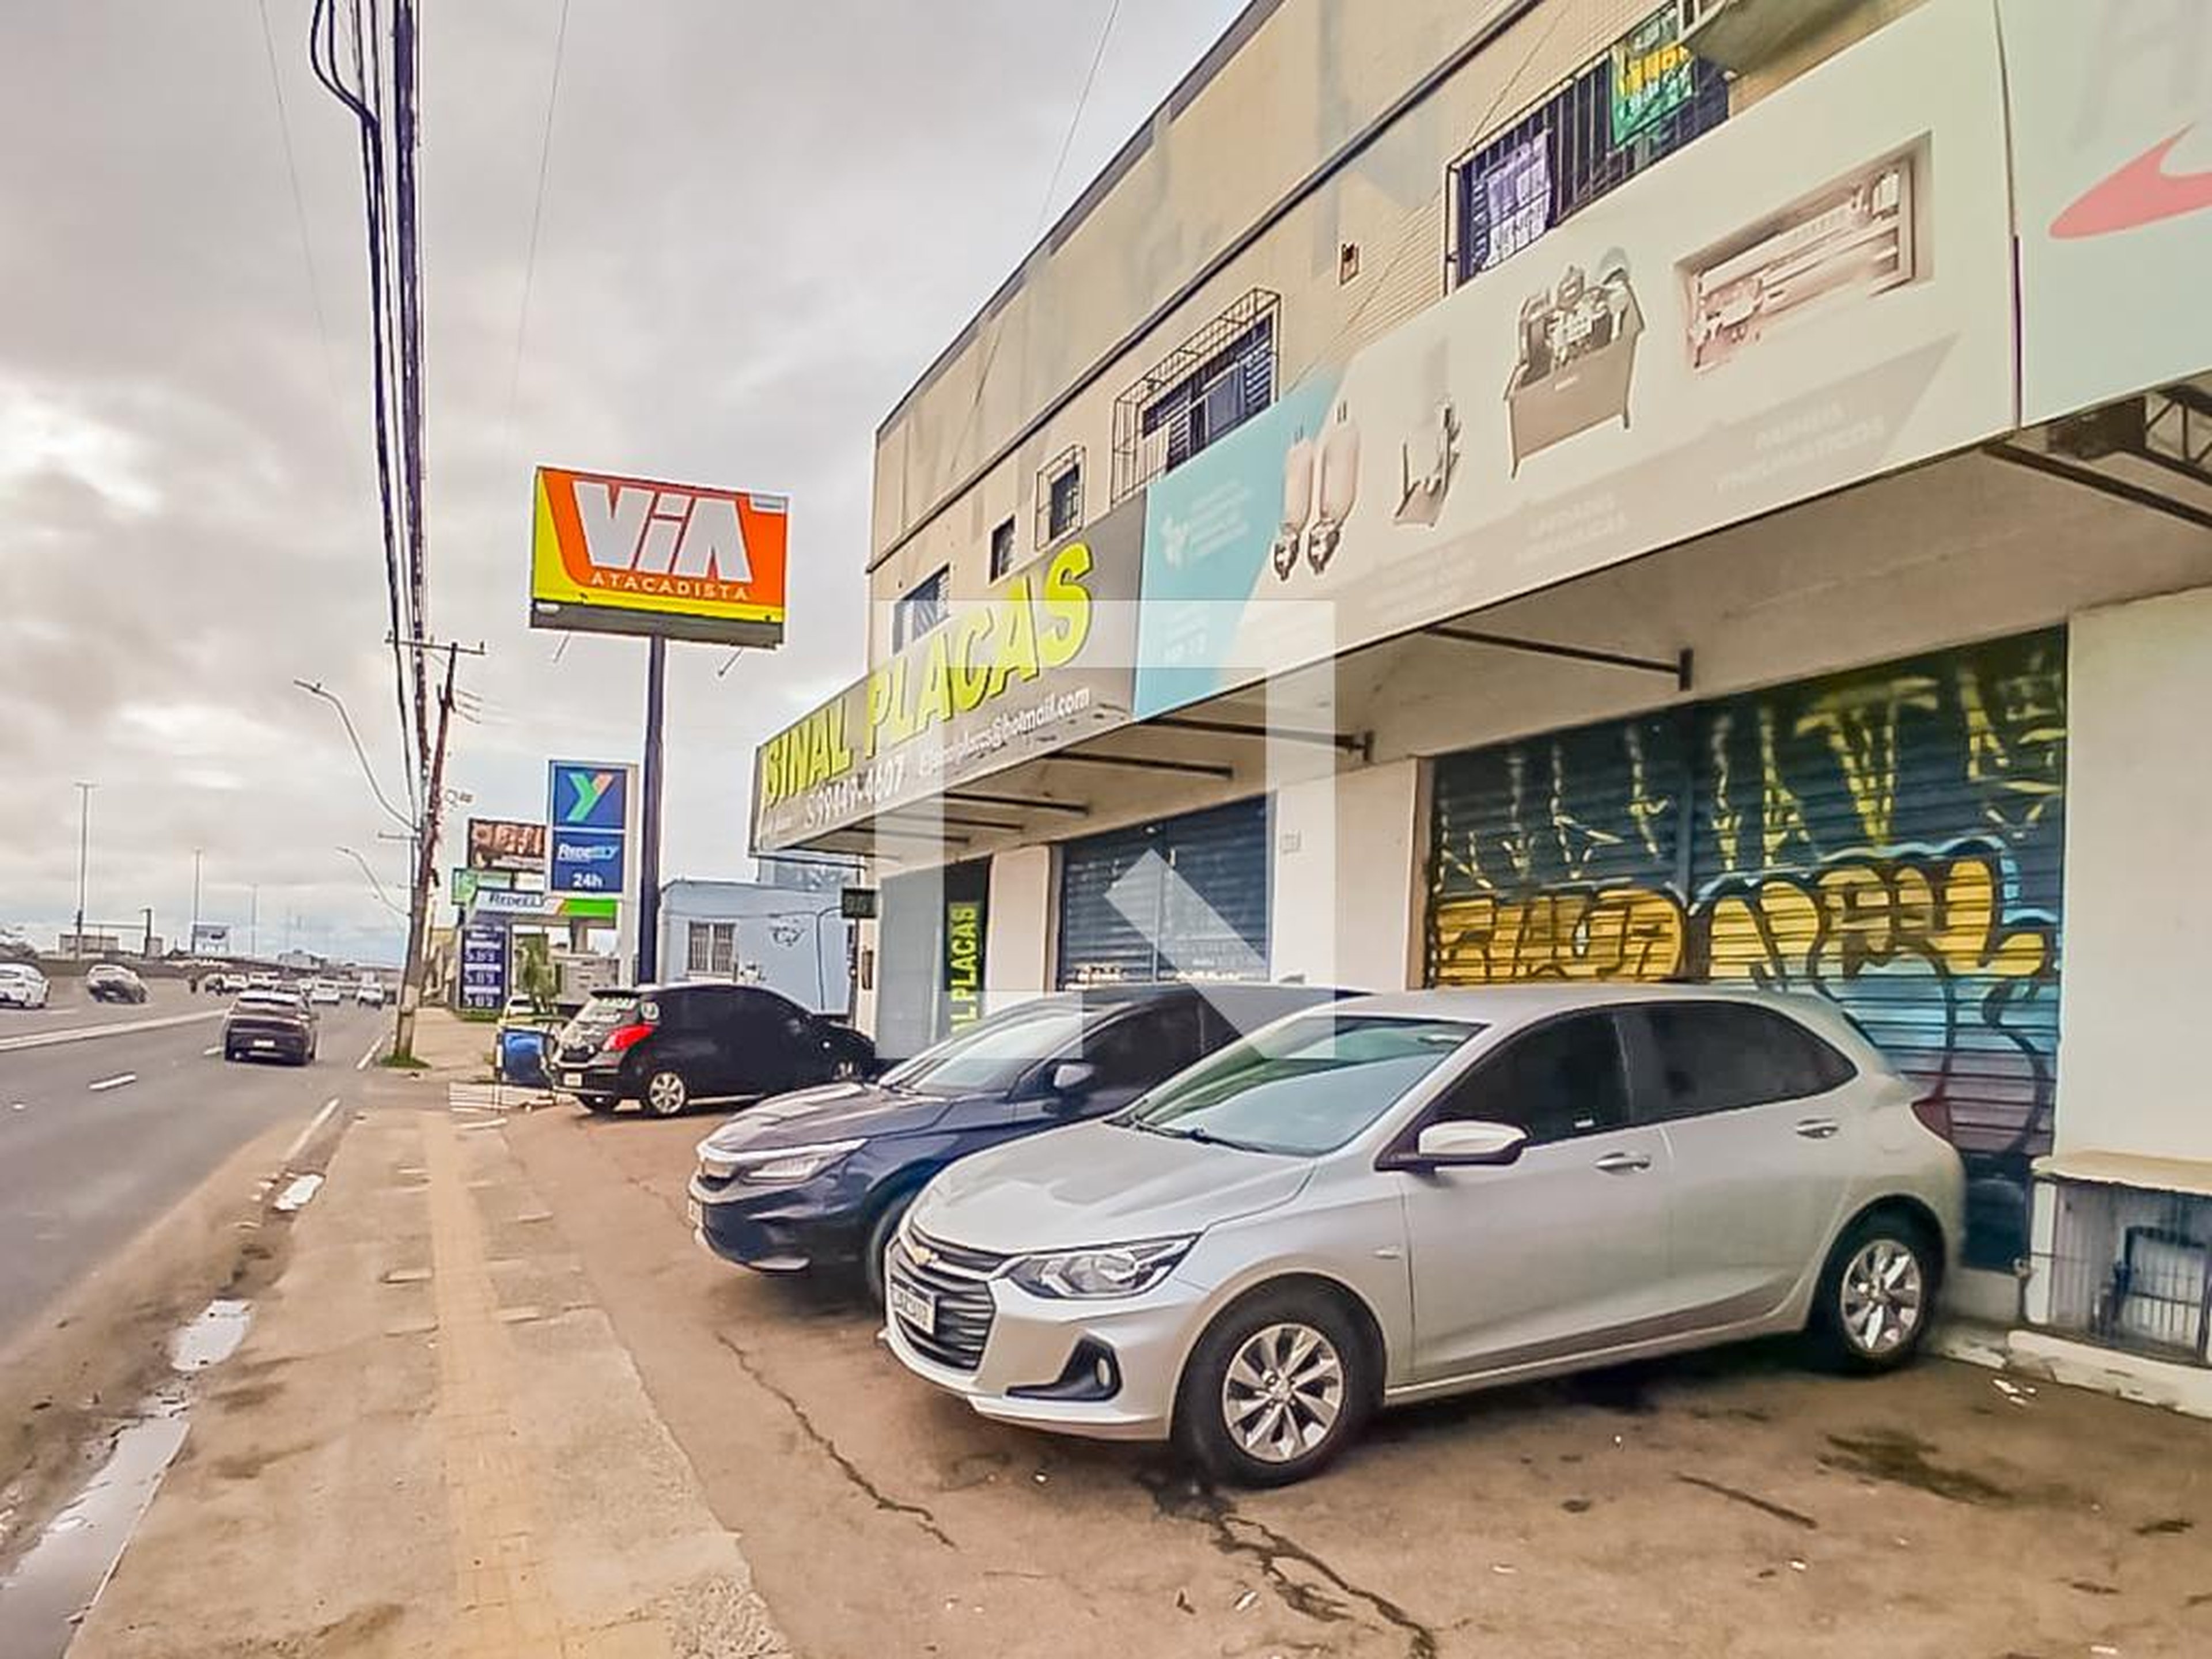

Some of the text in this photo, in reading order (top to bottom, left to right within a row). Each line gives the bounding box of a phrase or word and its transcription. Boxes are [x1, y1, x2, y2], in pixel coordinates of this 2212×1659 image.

[590, 571, 749, 601] ATACADISTA
[762, 541, 1094, 809] SINAL PLACAS
[950, 903, 978, 1002] PLACAS
